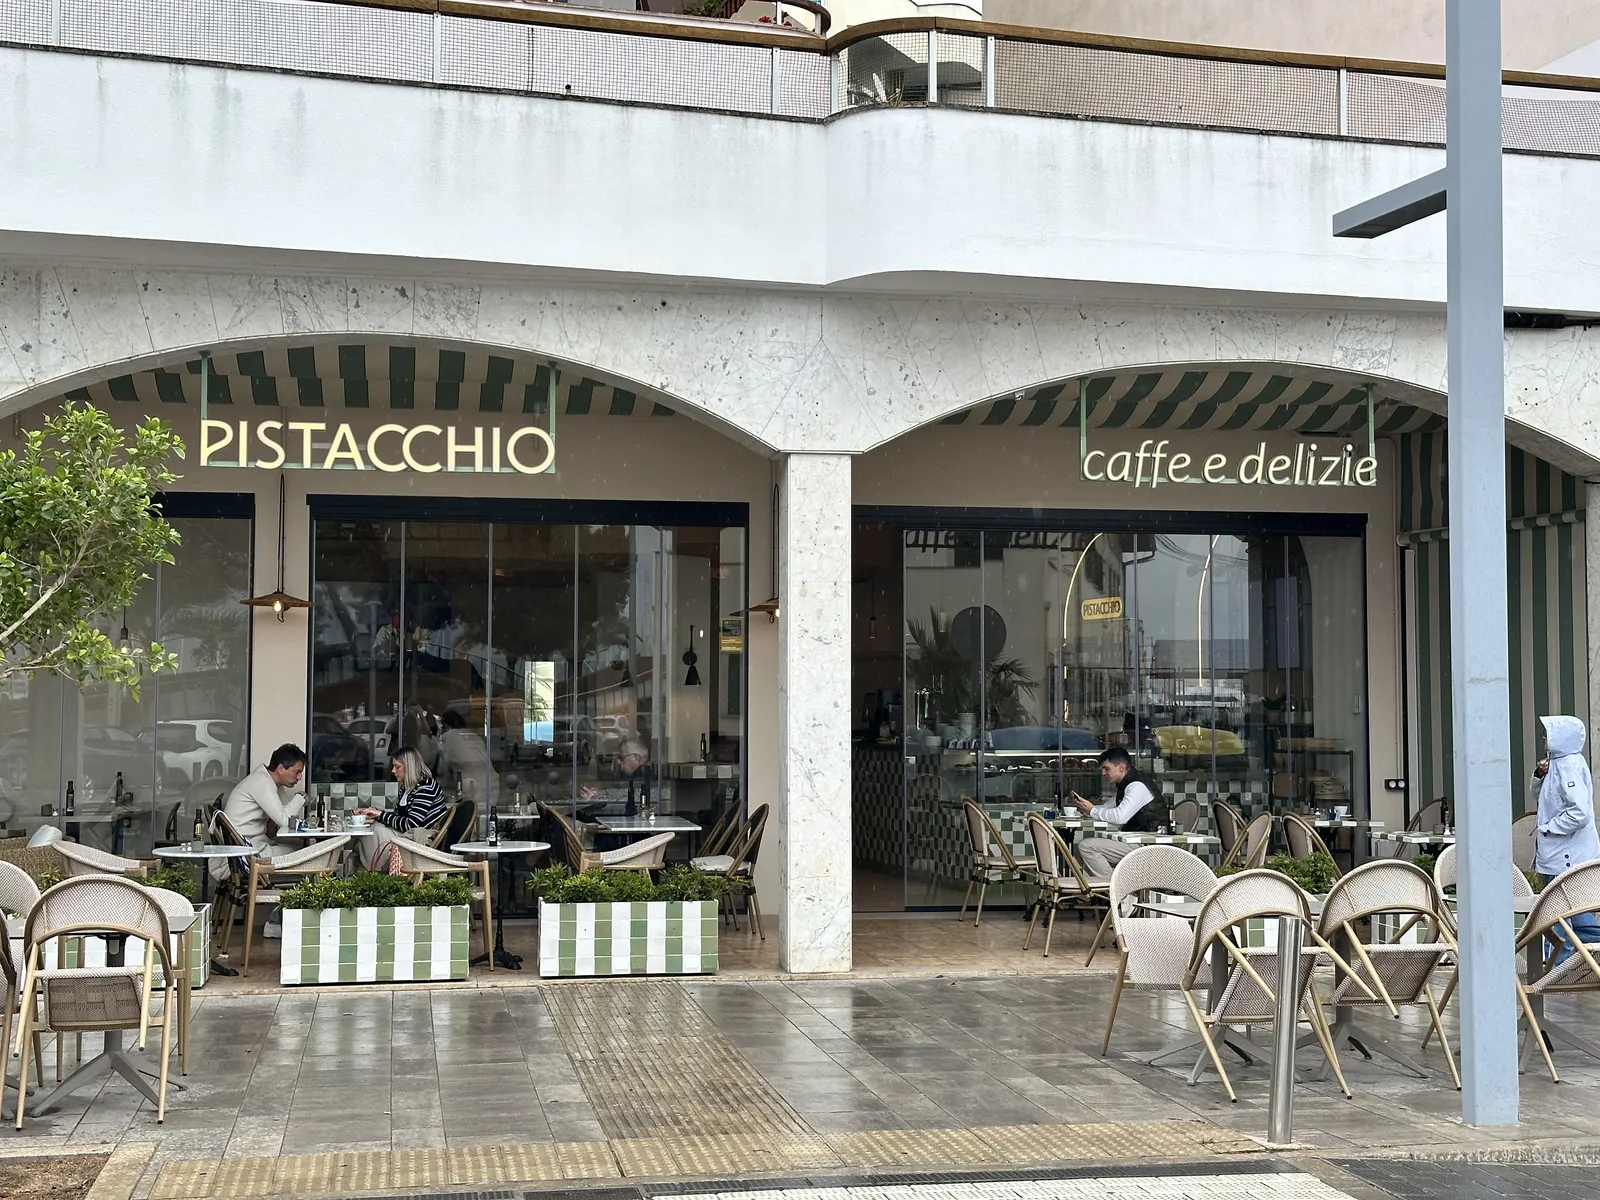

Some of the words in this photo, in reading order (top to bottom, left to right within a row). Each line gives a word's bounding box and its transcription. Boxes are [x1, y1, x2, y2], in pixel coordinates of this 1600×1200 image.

[200, 420, 555, 475] PISTACCHIO
[1083, 440, 1191, 488] caffe
[1201, 452, 1227, 483] e
[1237, 442, 1378, 486] delizie
[1083, 600, 1121, 616] PISTACCHIO
